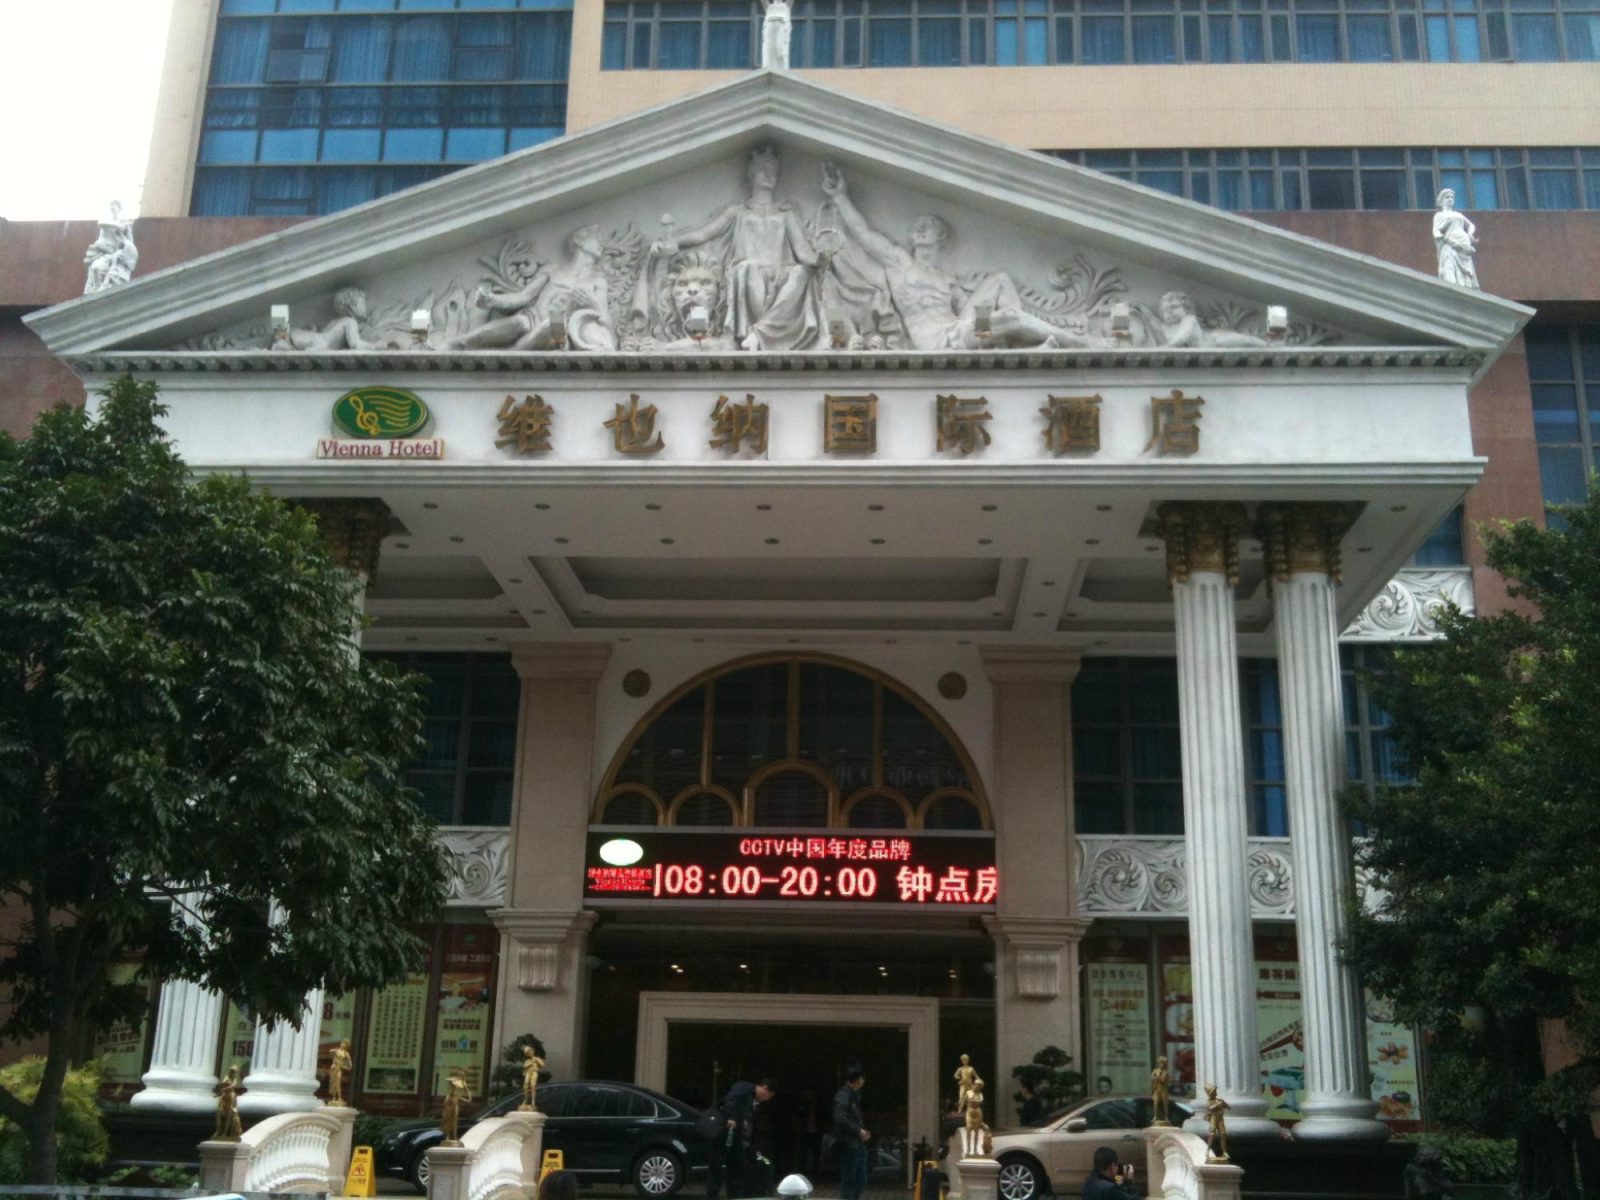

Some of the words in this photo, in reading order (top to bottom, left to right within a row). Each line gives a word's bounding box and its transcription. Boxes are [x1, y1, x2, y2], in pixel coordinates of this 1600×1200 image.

[494, 389, 1205, 456] 维也纳国际酒店
[321, 440, 383, 456] Vienna
[388, 440, 438, 456] Hotel
[738, 838, 911, 861] CCTV中国年度品牌
[653, 864, 877, 898] 08:00-20:00
